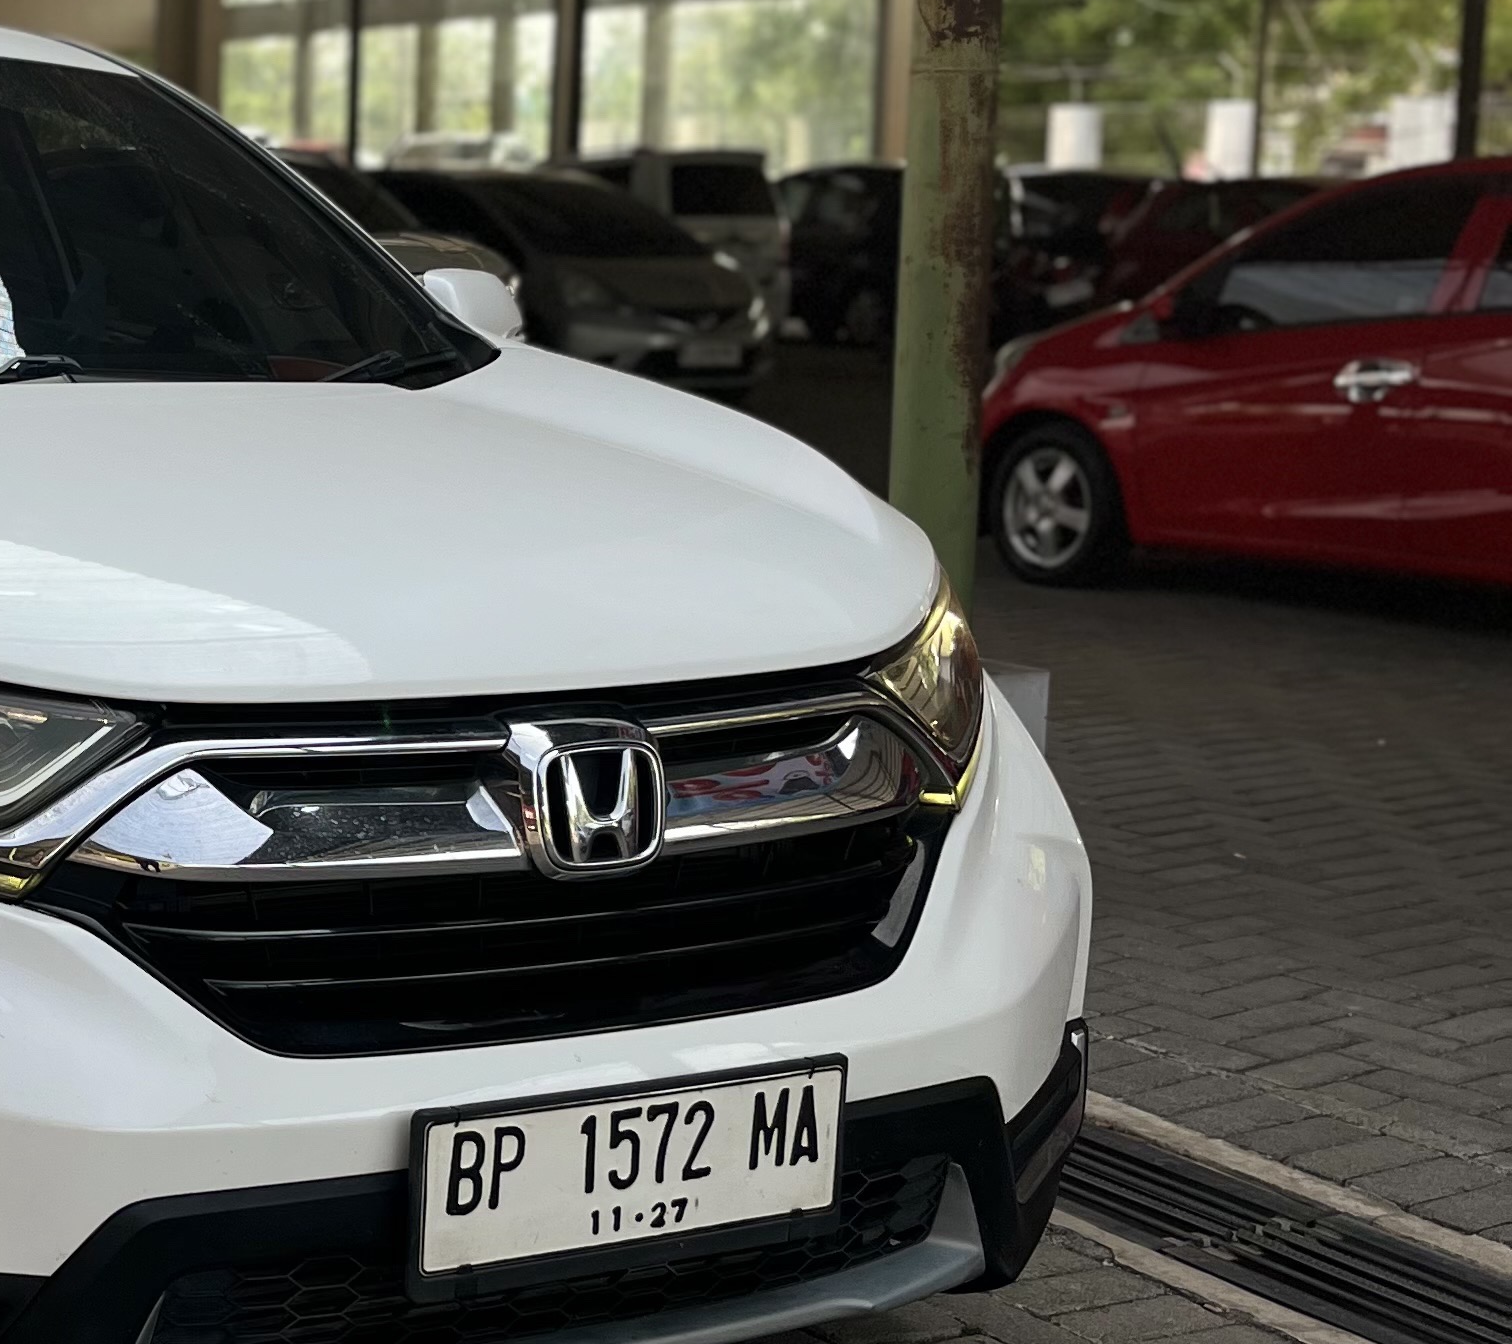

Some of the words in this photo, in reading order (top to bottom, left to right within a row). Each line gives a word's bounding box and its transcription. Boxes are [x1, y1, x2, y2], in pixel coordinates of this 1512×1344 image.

[445, 1126, 526, 1216] BP
[581, 1100, 716, 1194] 1572
[748, 1085, 819, 1170] MA
